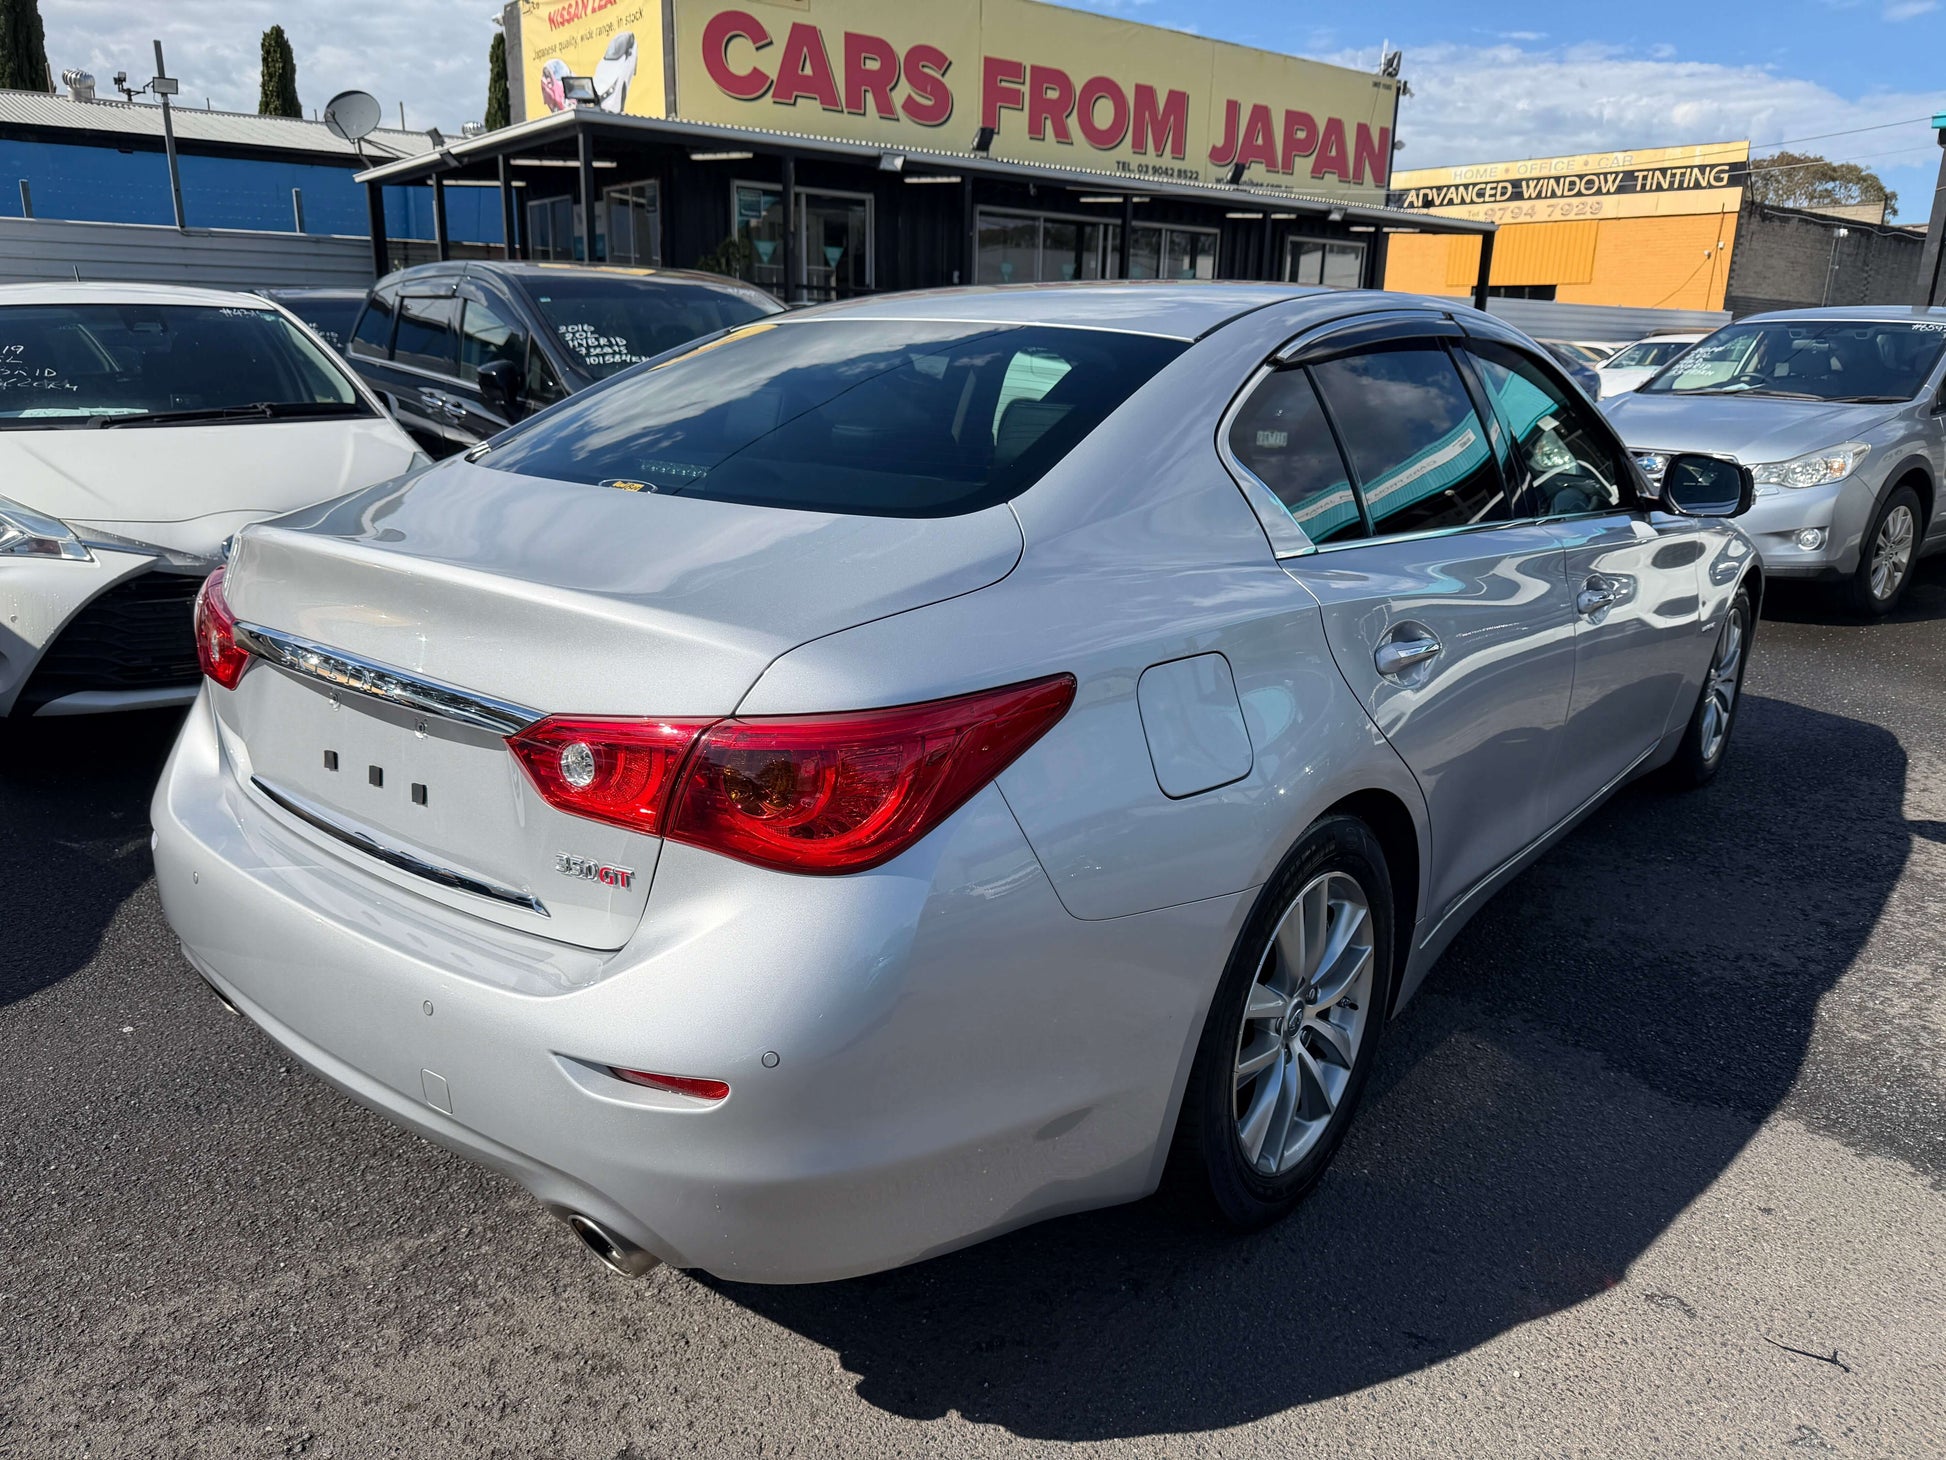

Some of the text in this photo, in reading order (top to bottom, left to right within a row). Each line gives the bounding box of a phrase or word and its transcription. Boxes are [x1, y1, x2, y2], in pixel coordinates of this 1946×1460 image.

[548, 0, 589, 32] NISSAN
[591, 0, 618, 14] LE
[533, 43, 557, 60] Japanese
[580, 27, 594, 41] wide
[625, 7, 644, 26] stock
[702, 10, 1390, 188] CARS FROM JAPAN
[1116, 160, 1200, 181] TEL. 03 9042 8522
[1453, 154, 1634, 182] HOME OFFICE CAR
[1403, 165, 1730, 208] ADVANCED WINDOW TINTING
[1484, 204, 1537, 222] 9794
[1545, 201, 1603, 218] 7929
[558, 323, 595, 334] 2016
[568, 336, 627, 348] HYBRID
